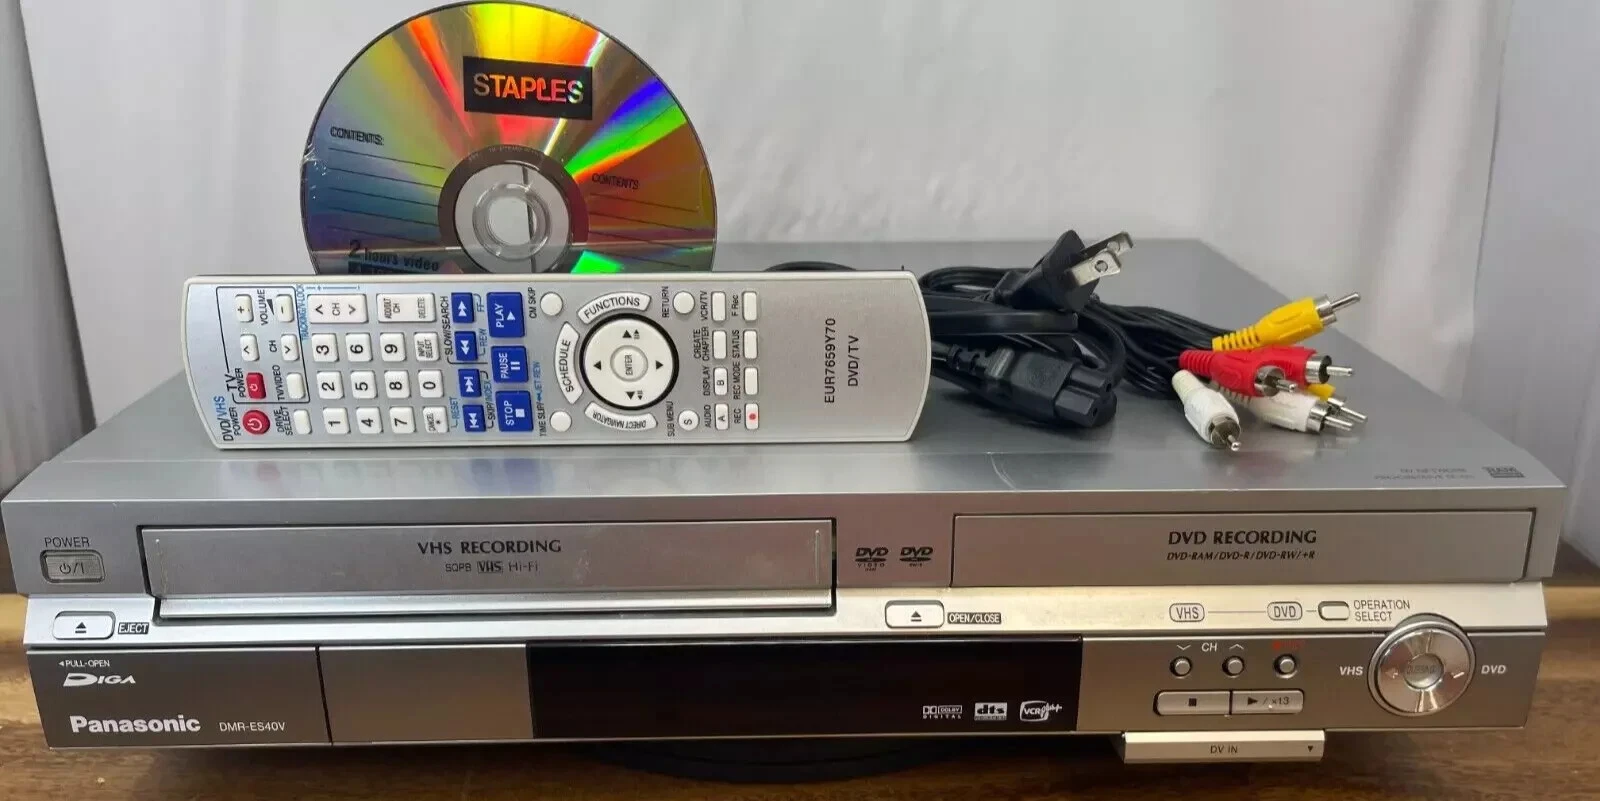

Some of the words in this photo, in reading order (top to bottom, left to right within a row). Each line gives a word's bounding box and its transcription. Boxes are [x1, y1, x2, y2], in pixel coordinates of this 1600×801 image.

[473, 72, 584, 104] STAPLES
[364, 247, 398, 266] hours
[403, 256, 441, 272] video
[527, 286, 537, 305] SKIP
[661, 285, 670, 318] RETURN
[257, 289, 269, 326] VOLUME
[331, 302, 341, 316] CH
[528, 306, 538, 319] CM
[583, 297, 641, 319] FUNCTIONS
[700, 290, 709, 321] VCR/TV
[494, 303, 505, 328] PLAY
[440, 295, 454, 356] SLOW/SEARCH
[269, 339, 278, 353] CH
[315, 344, 330, 355] 3
[350, 343, 364, 354] 6
[384, 343, 398, 354] 9
[693, 328, 702, 359] CREATE
[701, 325, 711, 362] CHAPTER
[731, 329, 740, 359] STATUS
[498, 352, 510, 380] PAUSE
[558, 338, 574, 393] SCHEDULE
[624, 354, 634, 376] ENTER
[824, 318, 836, 403] EUR7659Y70
[847, 335, 860, 387] DVD/TV
[732, 362, 741, 384] MODE
[224, 373, 238, 393] TV
[235, 367, 246, 398] POWER
[273, 364, 285, 401] TV/VIDEO
[321, 380, 336, 392] 2
[354, 380, 369, 392] 5
[388, 379, 403, 391] 8
[422, 381, 437, 390] 0
[702, 365, 711, 397] DISPLAY
[716, 379, 725, 387] B
[732, 386, 741, 400] REC
[213, 395, 234, 442] DVD/VHS
[503, 400, 515, 427] STOP
[665, 401, 674, 422] MENU
[703, 404, 712, 428] AUDIO
[733, 407, 742, 424] REC
[228, 406, 241, 436] POWER
[273, 408, 284, 433] DRIVE
[280, 406, 293, 436] SELECT
[360, 417, 373, 428] 4
[393, 416, 408, 427] 7
[592, 411, 625, 429] NAVIGATOR
[625, 420, 647, 429] DIRECT
[683, 418, 693, 426] S
[667, 423, 676, 437] SUB
[44, 537, 90, 549] POWER
[1168, 531, 1207, 545] DVD
[1213, 530, 1317, 544] RECORDING
[417, 541, 453, 555] VHS
[460, 539, 562, 554] RECORDING
[855, 547, 889, 560] DVD
[900, 546, 934, 558] DVD
[477, 560, 503, 574] VHS
[508, 560, 538, 573] Hi-Fi
[1273, 605, 1297, 618] DVD
[1353, 599, 1411, 611] OPERATION
[948, 613, 1001, 624] OPEN/CLOSE
[1176, 606, 1200, 620] VHS
[1355, 611, 1393, 622] SELECT
[118, 623, 149, 635] EJECT
[1201, 642, 1218, 652] CH
[65, 659, 110, 668] PULL-OPEN
[1339, 666, 1363, 676] VHS
[1481, 664, 1507, 675] DVD
[63, 672, 136, 687] DIGA
[976, 703, 1007, 715] dts
[70, 714, 201, 734] Panasonic
[219, 721, 286, 733] DMR-ES40V
[1210, 745, 1223, 755] DV
[1227, 745, 1238, 754] IN
